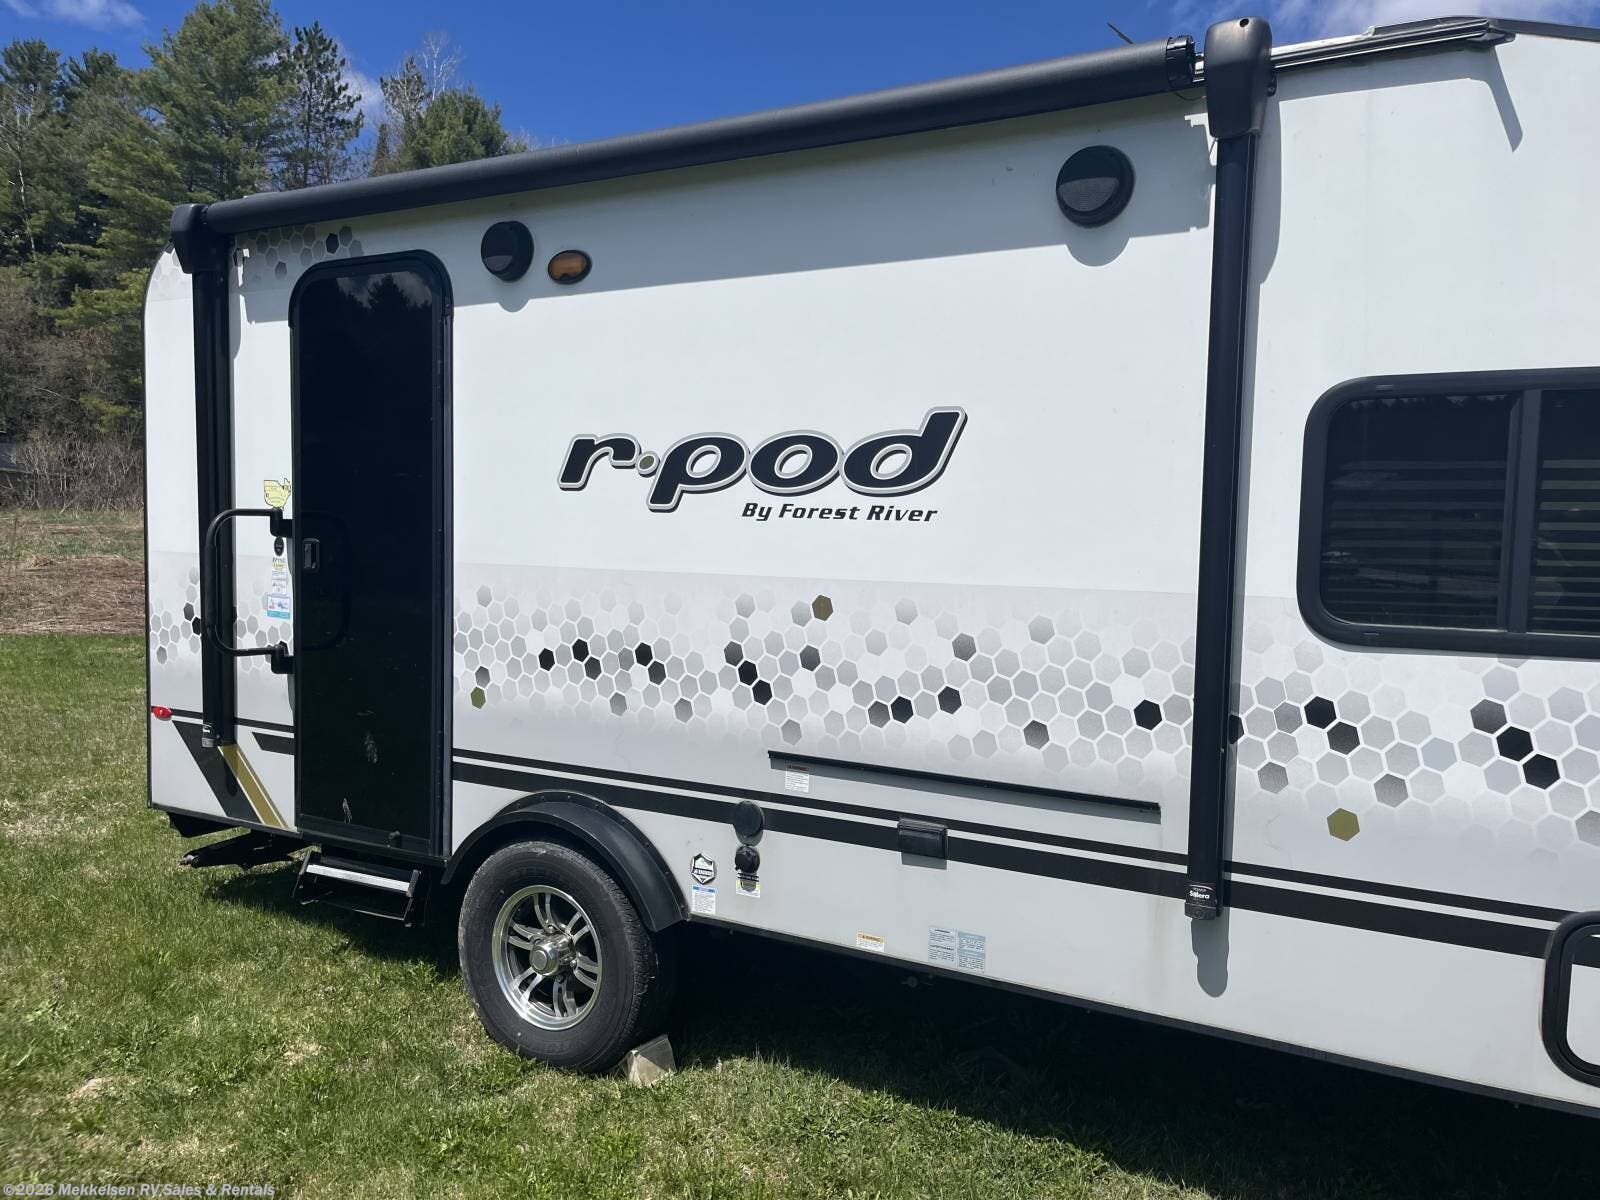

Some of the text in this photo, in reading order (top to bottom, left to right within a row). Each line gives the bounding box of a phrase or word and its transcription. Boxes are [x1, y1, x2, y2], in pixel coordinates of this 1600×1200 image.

[742, 502, 938, 522] By Forest River
